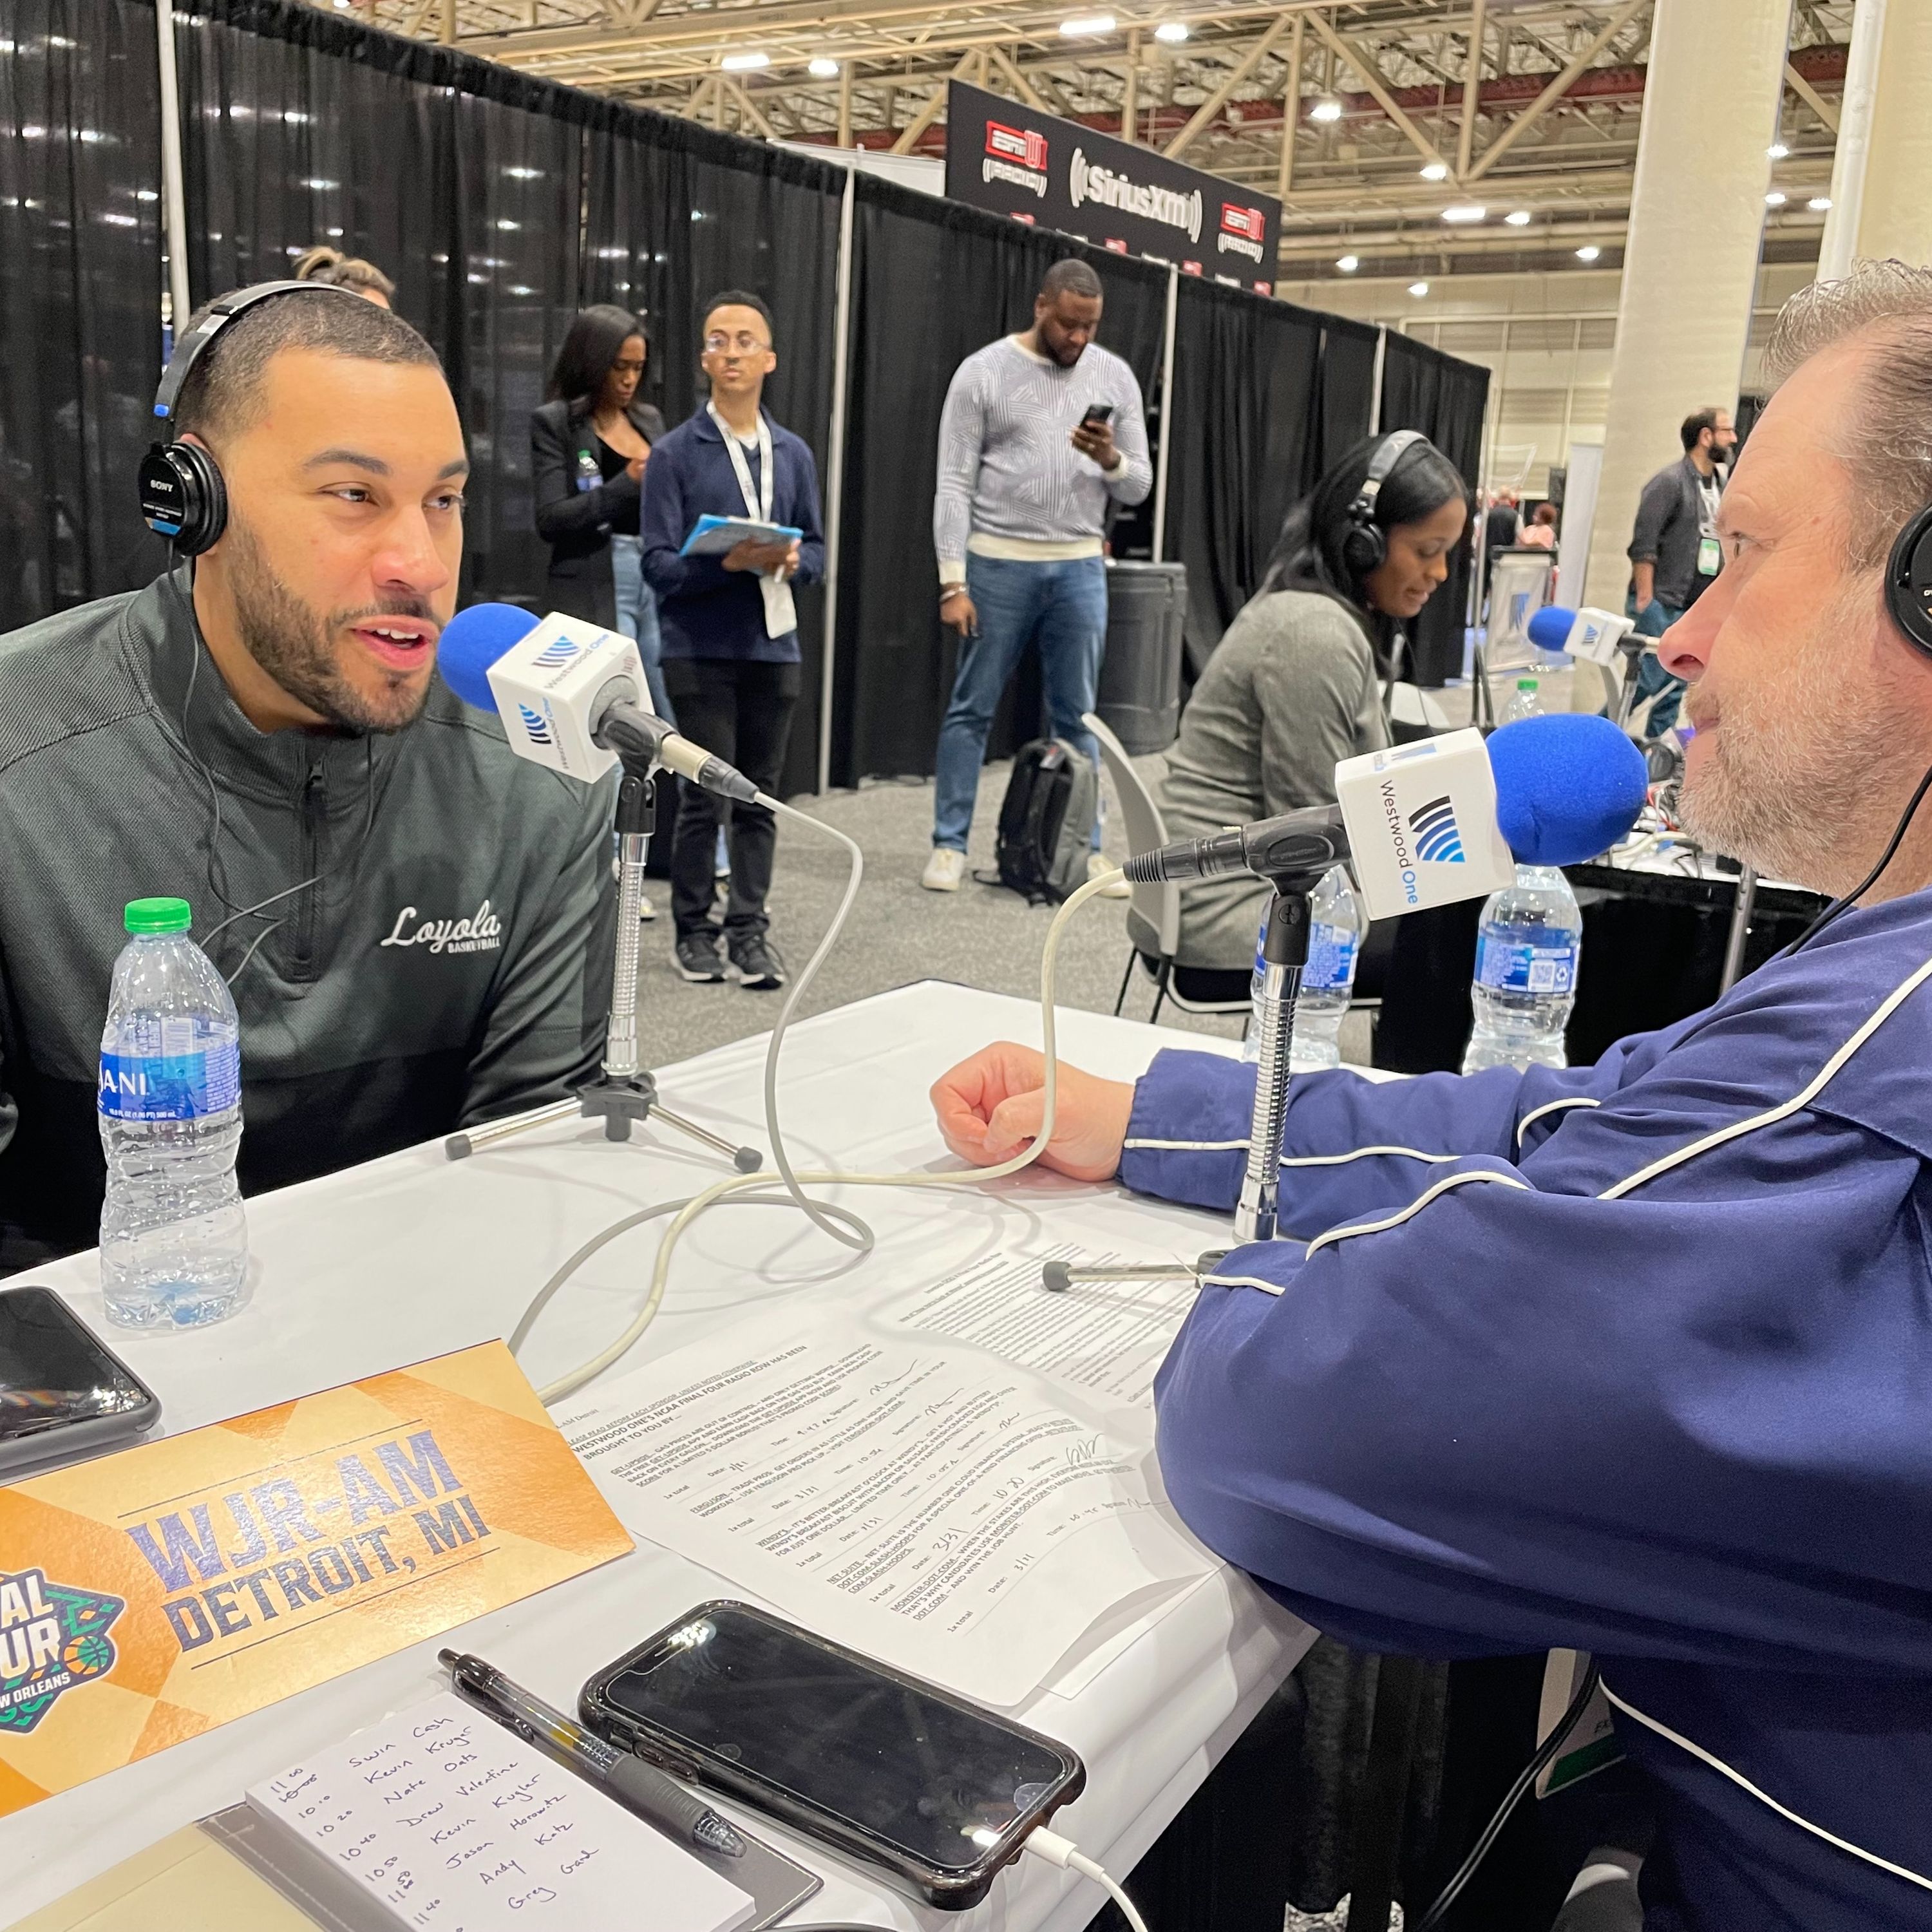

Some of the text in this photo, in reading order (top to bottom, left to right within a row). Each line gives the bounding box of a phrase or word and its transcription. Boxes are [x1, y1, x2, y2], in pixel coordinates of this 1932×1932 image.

[150, 479, 173, 492] SONY
[544, 634, 609, 689] Westwood One
[1380, 779, 1413, 868] Westwood
[1403, 871, 1418, 904] One
[380, 899, 501, 954] Loyola
[448, 936, 500, 953] BASKETBALL
[571, 1426, 630, 1452] WESTWOOD
[652, 1403, 681, 1417] NCAA
[676, 1391, 705, 1405] FINAL
[700, 1381, 727, 1394] FOUR
[723, 1370, 753, 1385] RADIO
[748, 1361, 773, 1373] ROW
[768, 1354, 789, 1363] HAS
[783, 1345, 809, 1356] BEEN
[603, 1415, 634, 1429] BEFORE
[924, 1427, 939, 1437] GET
[581, 1422, 663, 1459] BROUGHT TO YOU
[730, 1479, 755, 1492] TRADE
[772, 1463, 789, 1472] GET
[738, 1488, 756, 1497] USE
[752, 1471, 790, 1490] FERGUSON
[786, 1464, 803, 1473] PRO
[124, 1430, 463, 1594] WJR-AM
[761, 1464, 905, 1551] WENDY'S BREAKFAST BISCUIT WITH BACON OR
[773, 1459, 923, 1557] FOR JUST ONE LIMITED TIME AT
[902, 1518, 918, 1530] THE
[914, 1495, 943, 1519] NUMBER
[940, 1485, 956, 1497] ONE
[953, 1468, 976, 1486] CLOUD
[911, 1521, 928, 1533] FOR
[930, 1497, 956, 1518] SPECIAL
[957, 1486, 1037, 1555] WHEN THE STAKES ARE THIS
[805, 1551, 823, 1563] total
[839, 1530, 859, 1542] Date:
[160, 1494, 491, 1653] DETROIT, MI
[878, 1584, 896, 1596] total
[911, 1556, 932, 1570] Date:
[898, 1596, 929, 1616] THAT'S
[923, 1582, 943, 1598] WHY
[939, 1548, 981, 1584] CANDIDATES
[977, 1535, 993, 1549] USE
[911, 1593, 950, 1620] DOT-COM
[949, 1574, 967, 1589] AND
[963, 1560, 981, 1576] WIN
[977, 1549, 992, 1562] THE
[989, 1537, 1005, 1550] JOB
[956, 1611, 974, 1626] total
[987, 1577, 1009, 1593] Date:
[14, 1672, 71, 1703] ORLEANS
[413, 1718, 453, 1738] Cash
[364, 1760, 413, 1784] Kevin
[384, 1779, 426, 1804] Nate
[395, 1803, 444, 1827] Drew
[430, 1819, 476, 1844] Kevin
[446, 1841, 494, 1870] Jason
[479, 1859, 527, 1885] Andy
[535, 1823, 574, 1846] Katz
[508, 1887, 557, 1909] Greg
